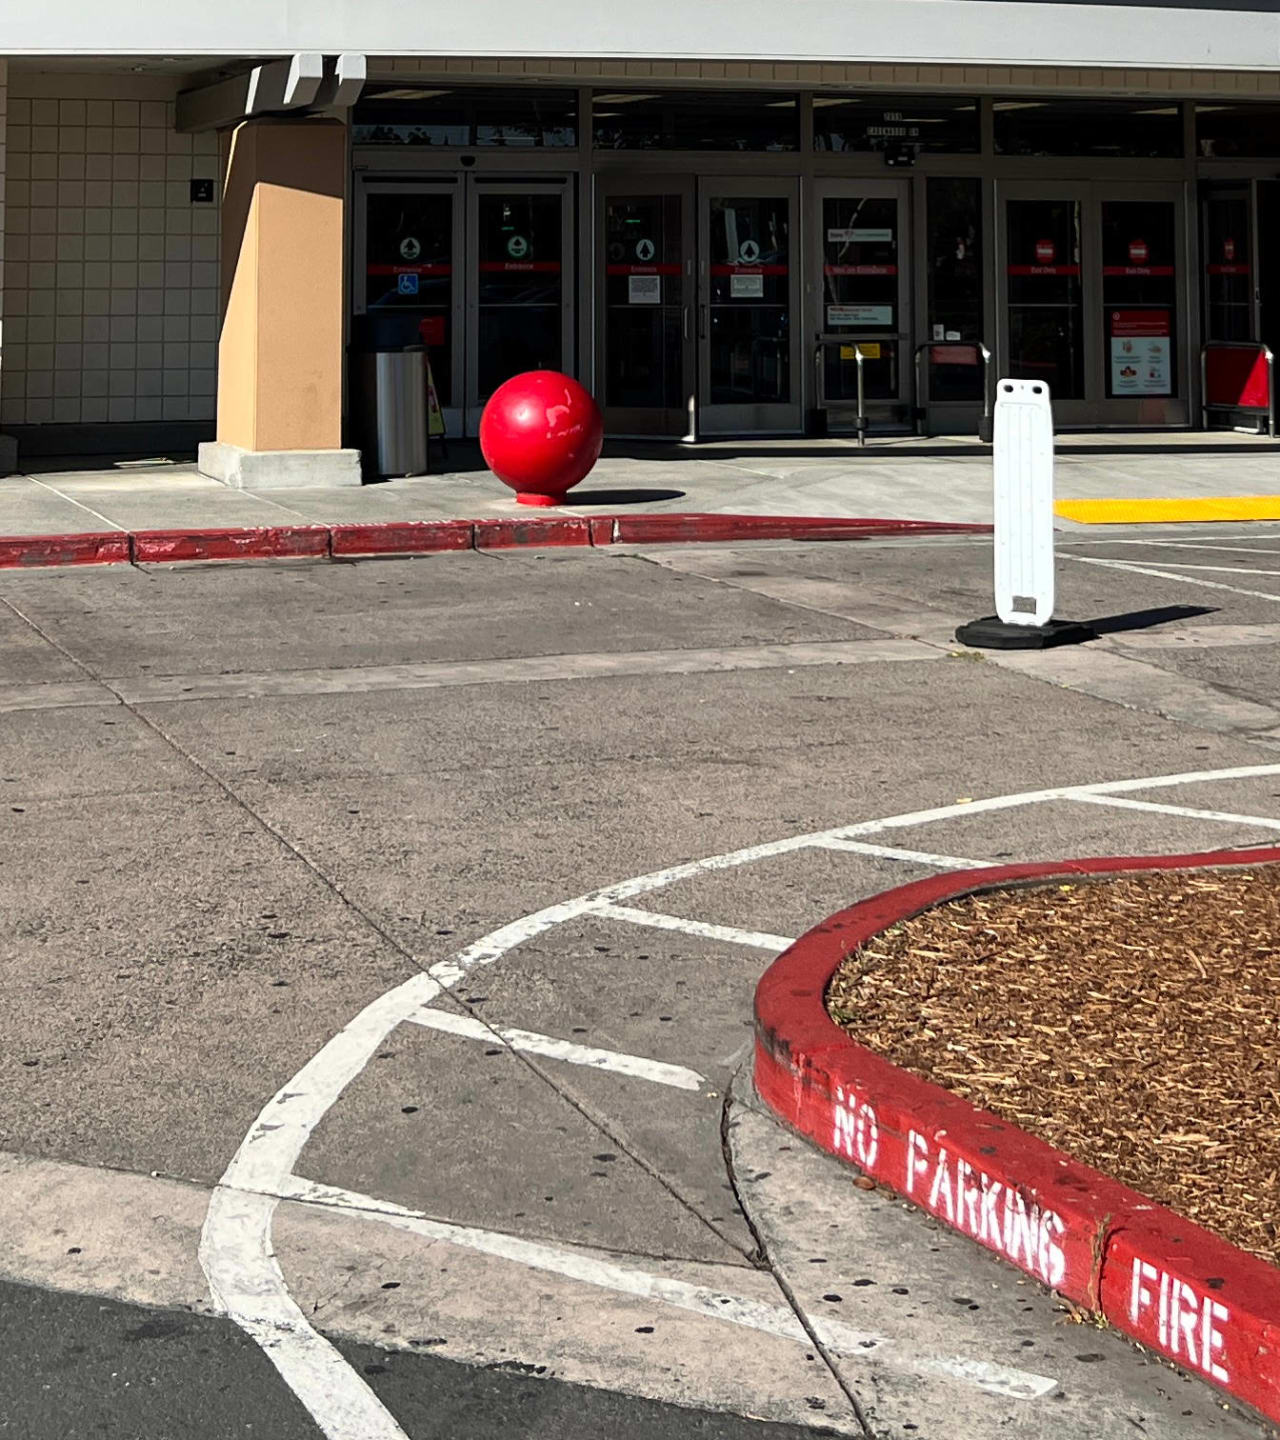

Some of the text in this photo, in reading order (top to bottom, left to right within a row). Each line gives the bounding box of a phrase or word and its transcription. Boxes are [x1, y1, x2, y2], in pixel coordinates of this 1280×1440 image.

[834, 1086, 878, 1167] NO
[906, 1129, 1066, 1286] PARKING
[1130, 1256, 1230, 1384] FIRE
